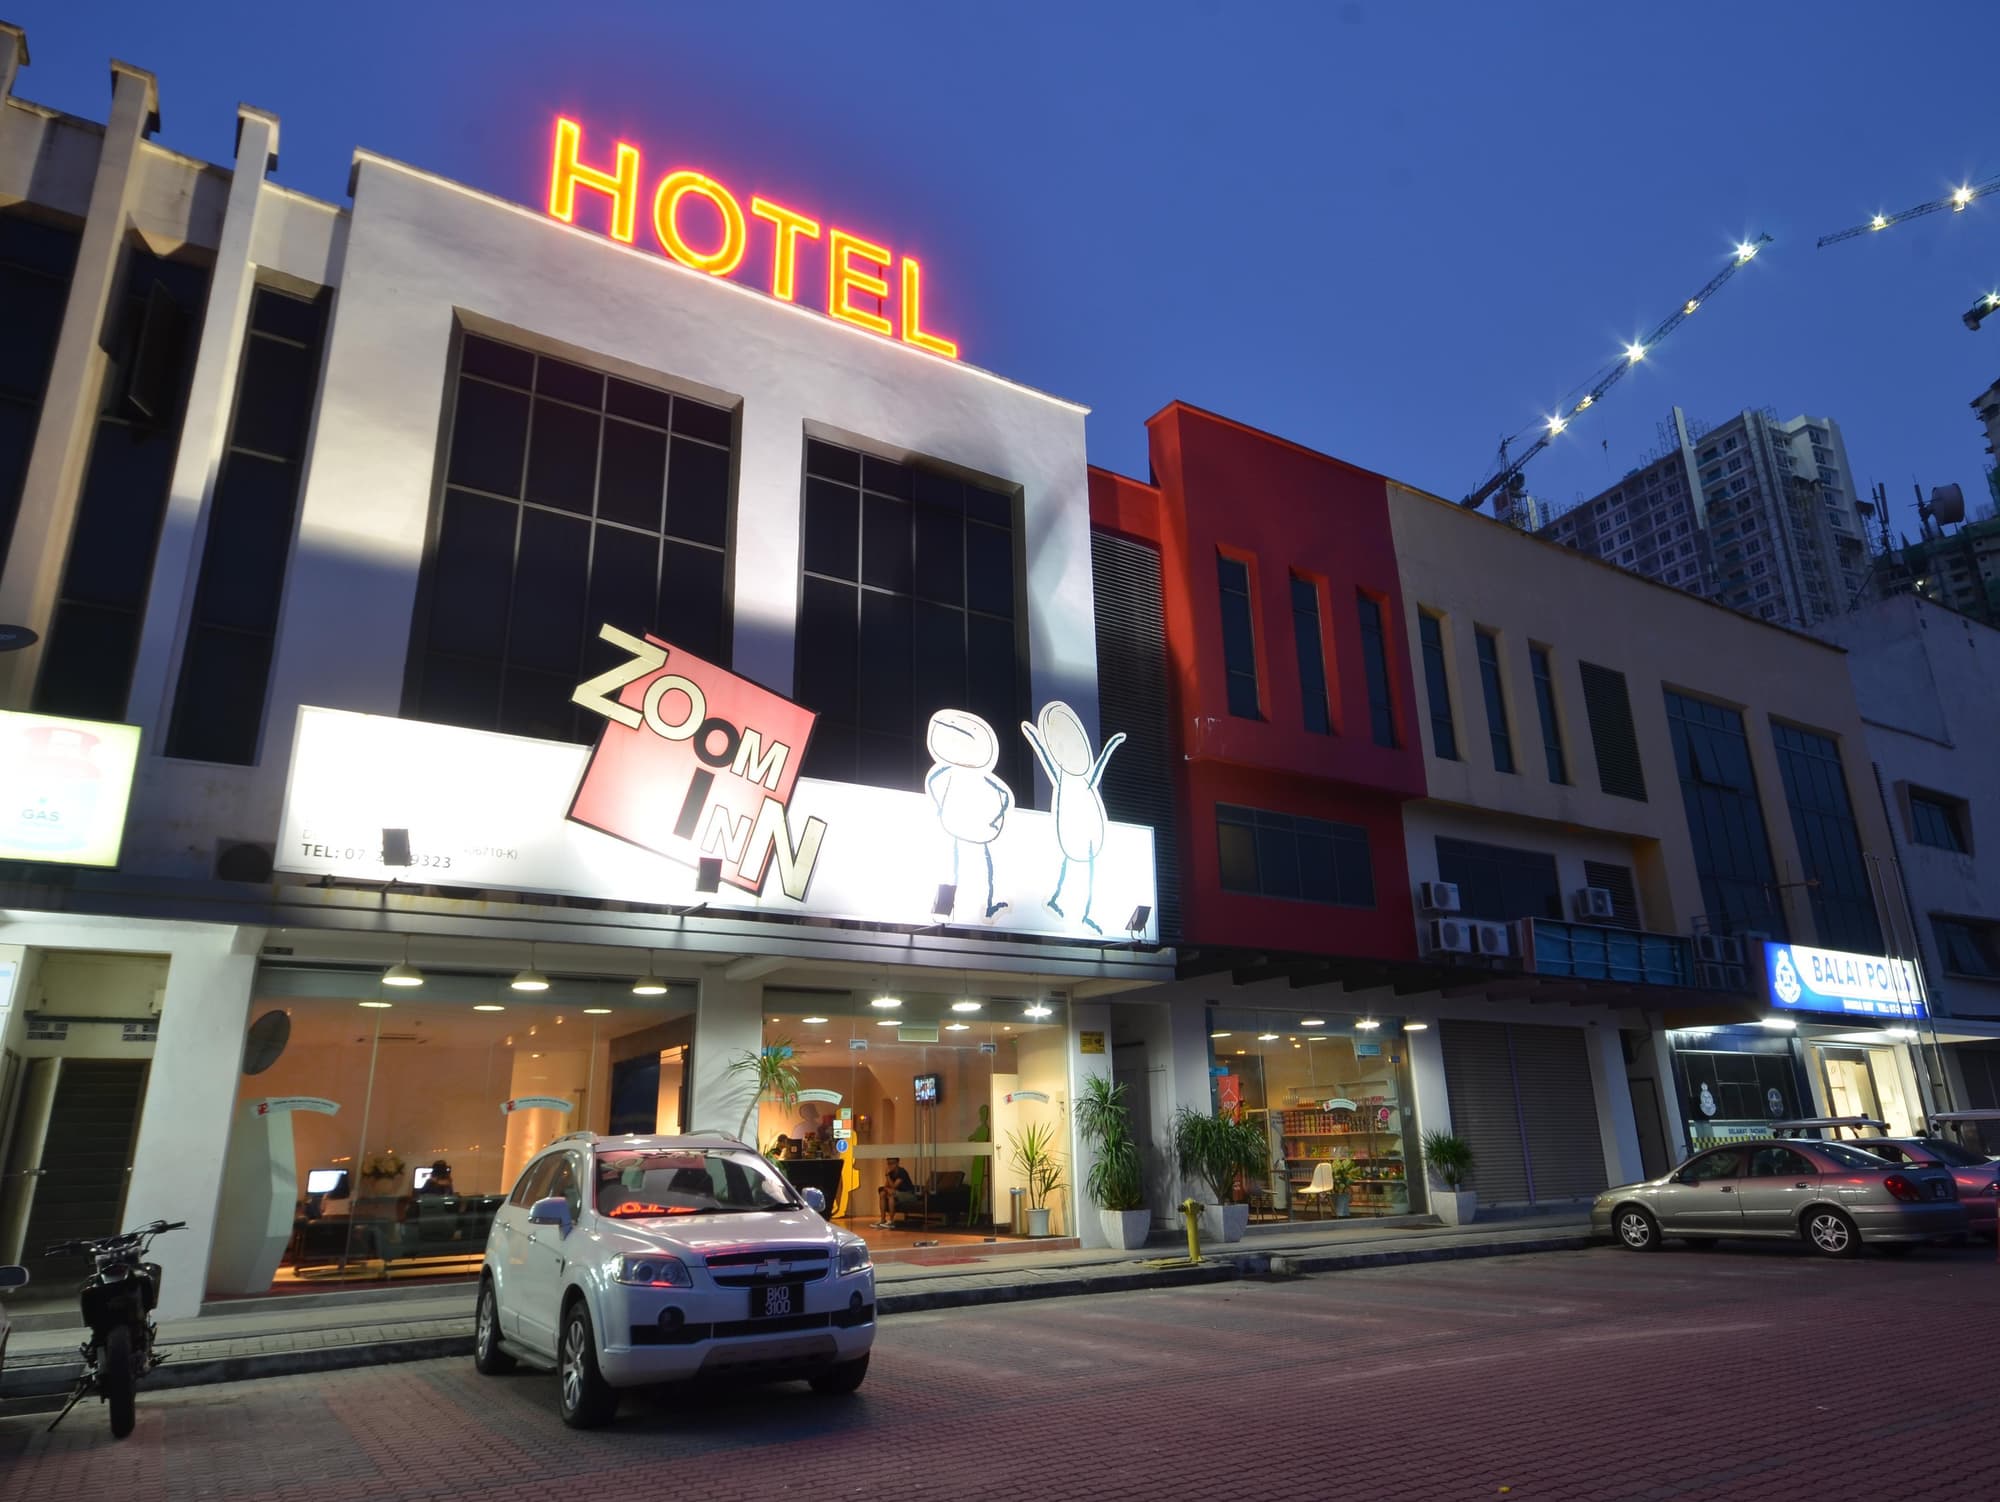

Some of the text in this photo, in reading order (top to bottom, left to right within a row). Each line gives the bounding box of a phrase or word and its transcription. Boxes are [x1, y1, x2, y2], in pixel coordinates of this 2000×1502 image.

[548, 116, 958, 360] HOTEL
[570, 622, 791, 792] ZOOM
[21, 808, 60, 822] GAS
[302, 843, 339, 859] TEL:
[1812, 955, 1862, 987] BALAI
[766, 1286, 790, 1301] BKD
[765, 1300, 791, 1316] 3100
